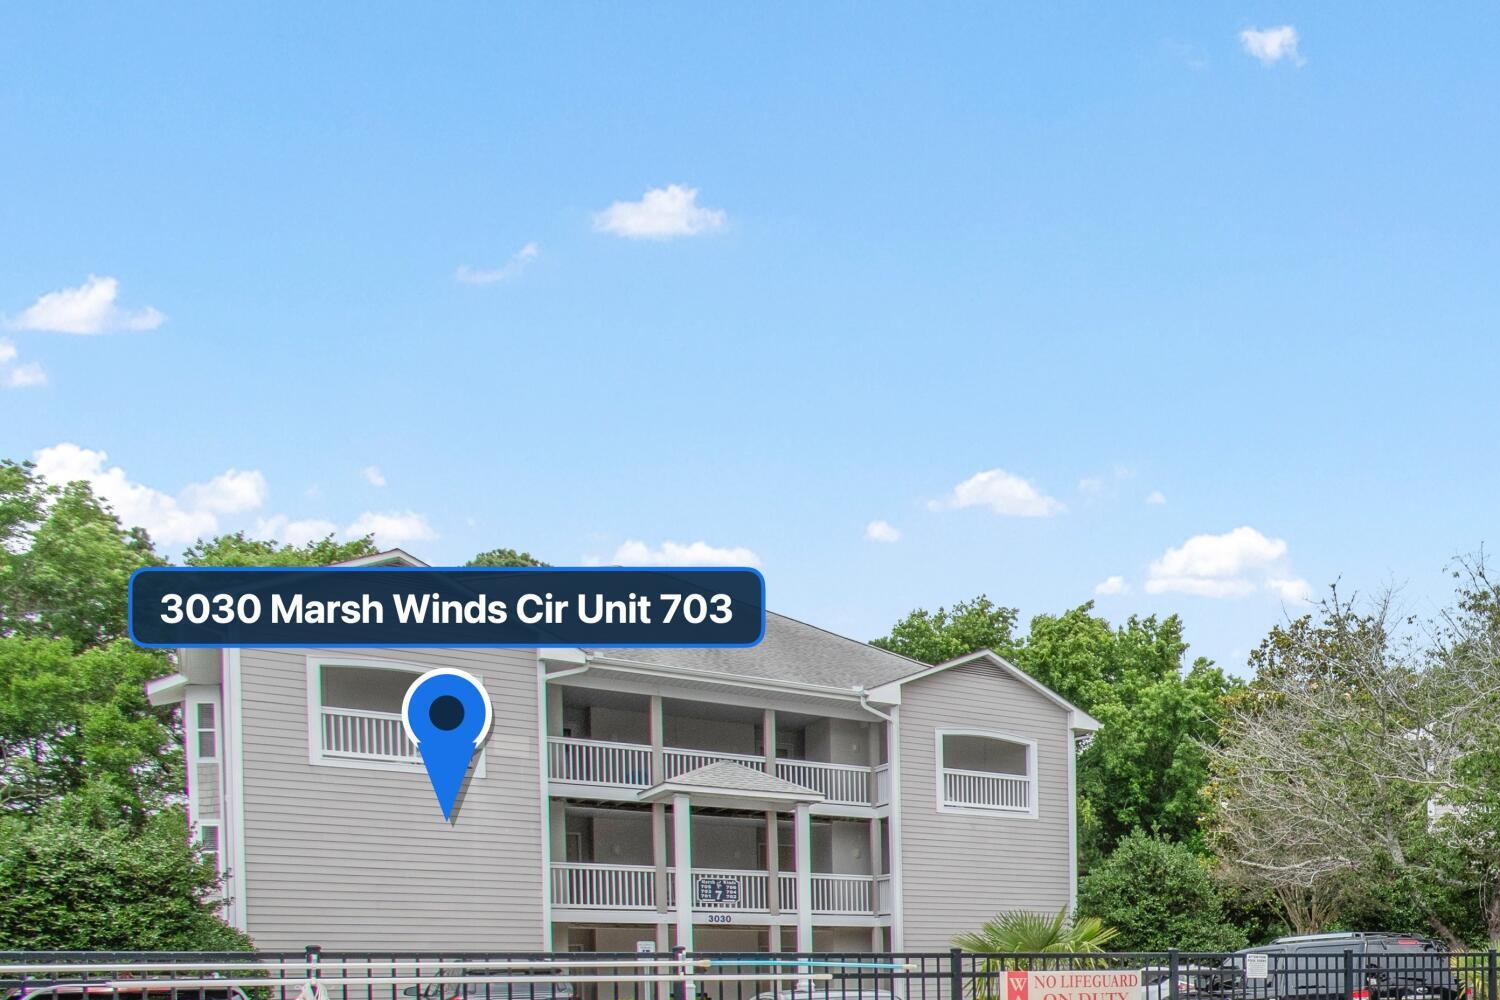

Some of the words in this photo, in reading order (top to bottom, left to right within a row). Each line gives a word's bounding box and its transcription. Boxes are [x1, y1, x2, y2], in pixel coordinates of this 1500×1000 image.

[715, 891, 723, 900] 7
[708, 915, 731, 923] 3030
[1034, 975, 1056, 989] NO
[1061, 974, 1138, 988] LIFEGUARD
